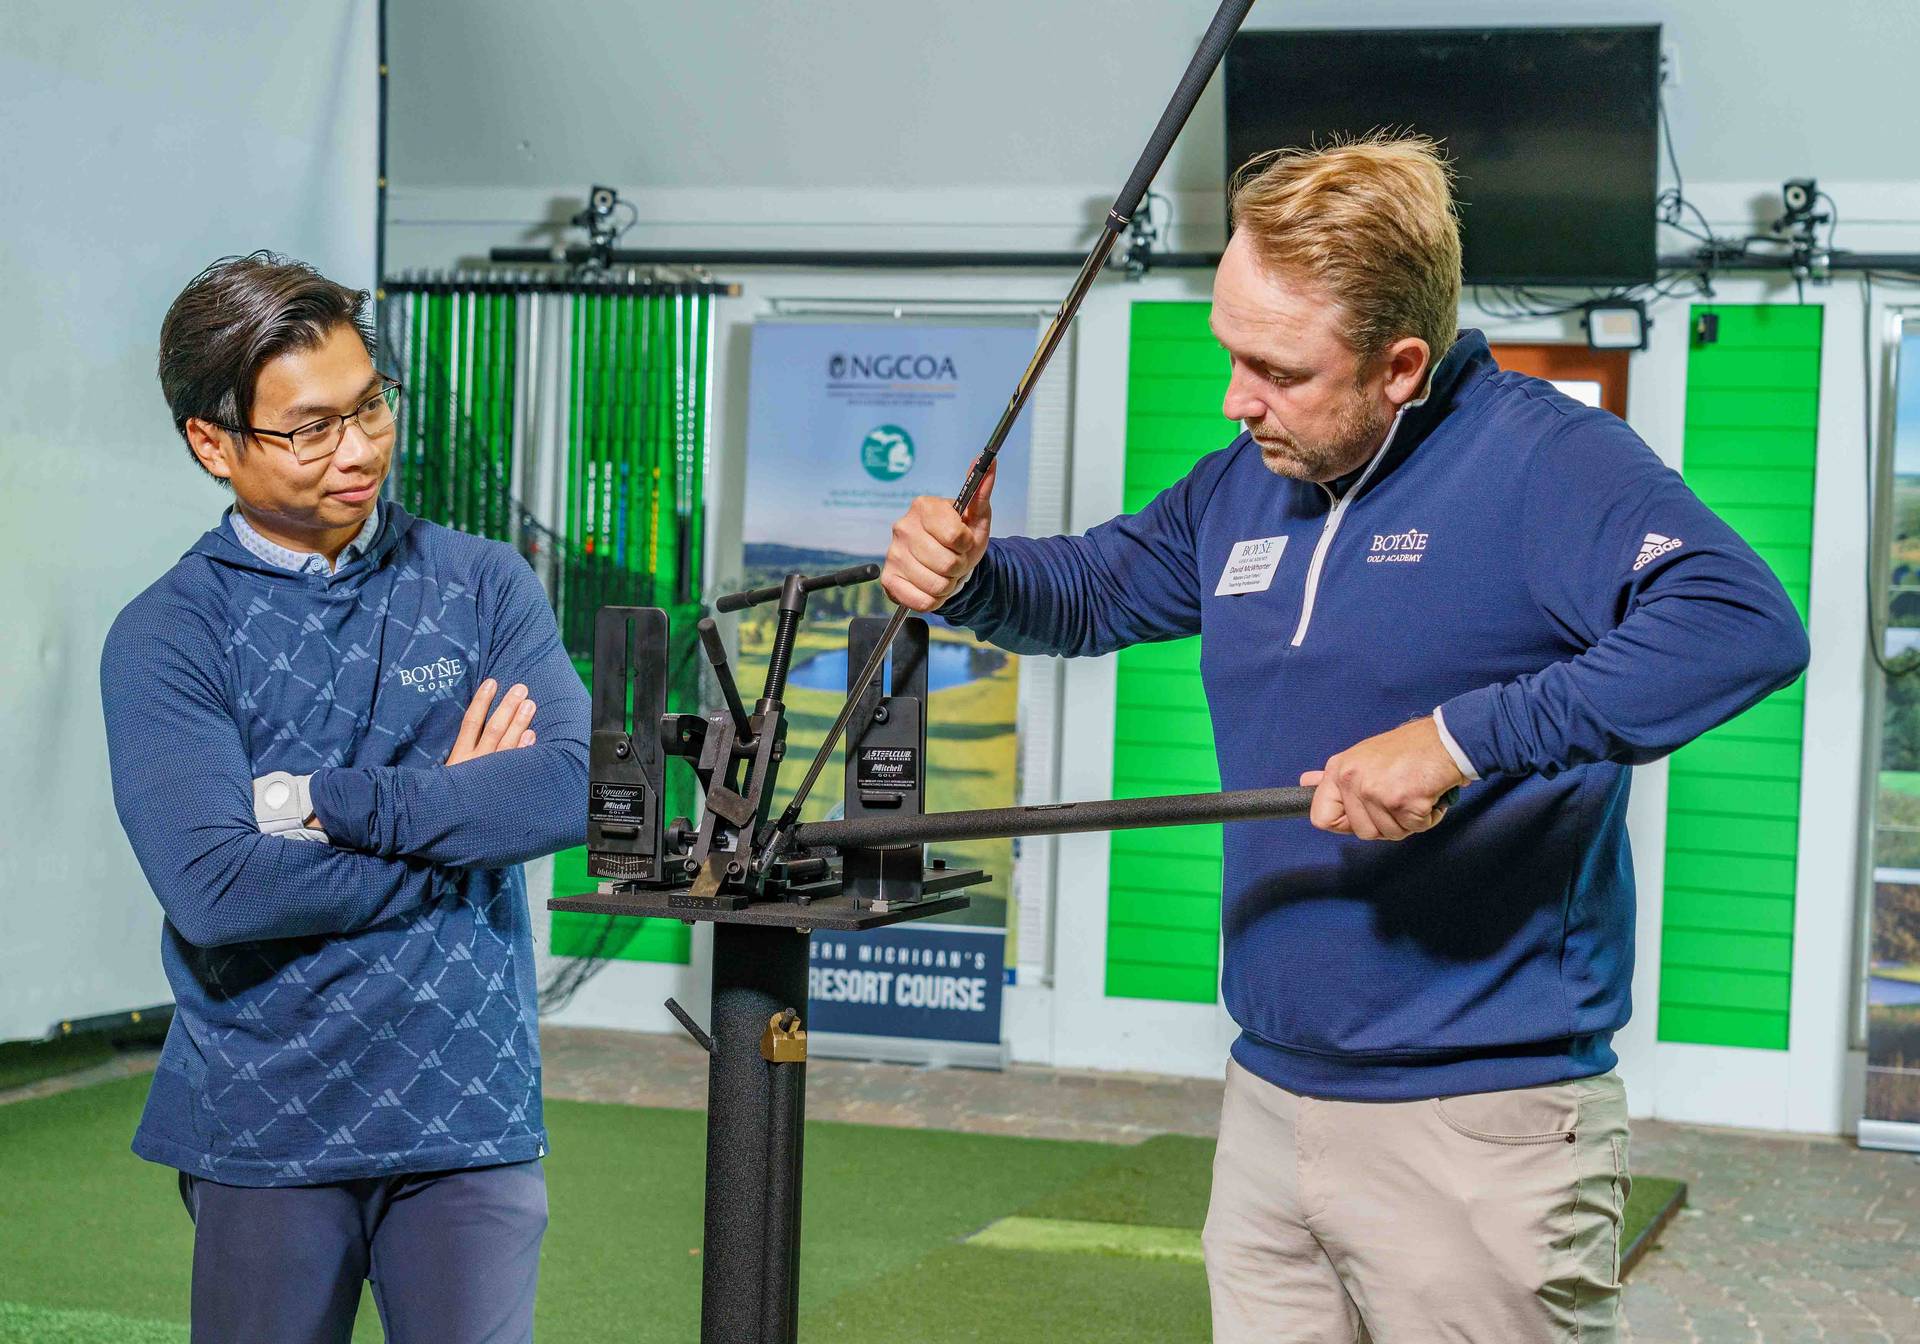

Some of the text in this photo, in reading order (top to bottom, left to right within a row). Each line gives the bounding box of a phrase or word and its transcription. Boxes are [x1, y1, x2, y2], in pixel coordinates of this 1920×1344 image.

[850, 354, 958, 380] NGCOA
[1242, 542, 1274, 556] BOYNE
[1370, 531, 1429, 551] BOYNE
[1367, 553, 1423, 563] GOLF ACADEMY
[1633, 538, 1683, 571] adidas
[400, 658, 462, 686] BOYNE
[417, 679, 454, 692] GOLF
[871, 763, 903, 772] Mitchell
[596, 785, 640, 798] Signature
[603, 801, 632, 811] Mitchell
[858, 943, 987, 970] MICHIGAN'S
[808, 966, 988, 1012] RESORT COURSE
